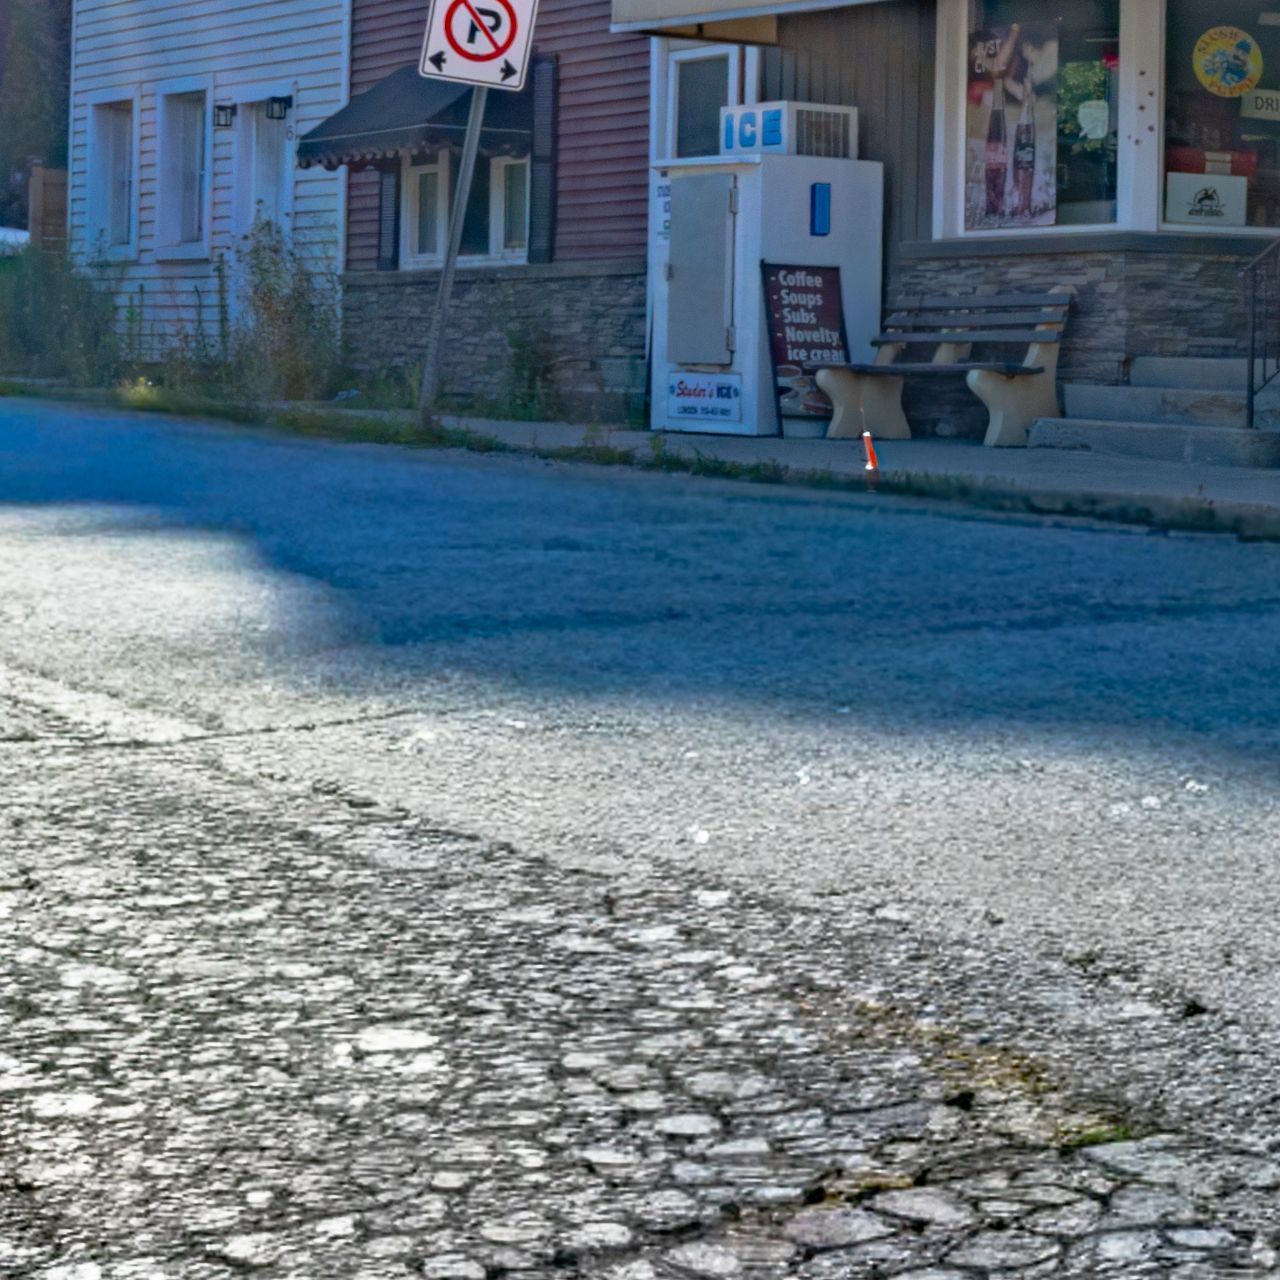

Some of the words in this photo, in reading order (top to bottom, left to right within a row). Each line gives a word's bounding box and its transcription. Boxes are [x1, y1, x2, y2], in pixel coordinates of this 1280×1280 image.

[725, 108, 782, 150] ICE
[778, 270, 823, 287] Coffee
[781, 289, 823, 309] Soups
[782, 308, 817, 324] Subs
[787, 344, 808, 361] ice
